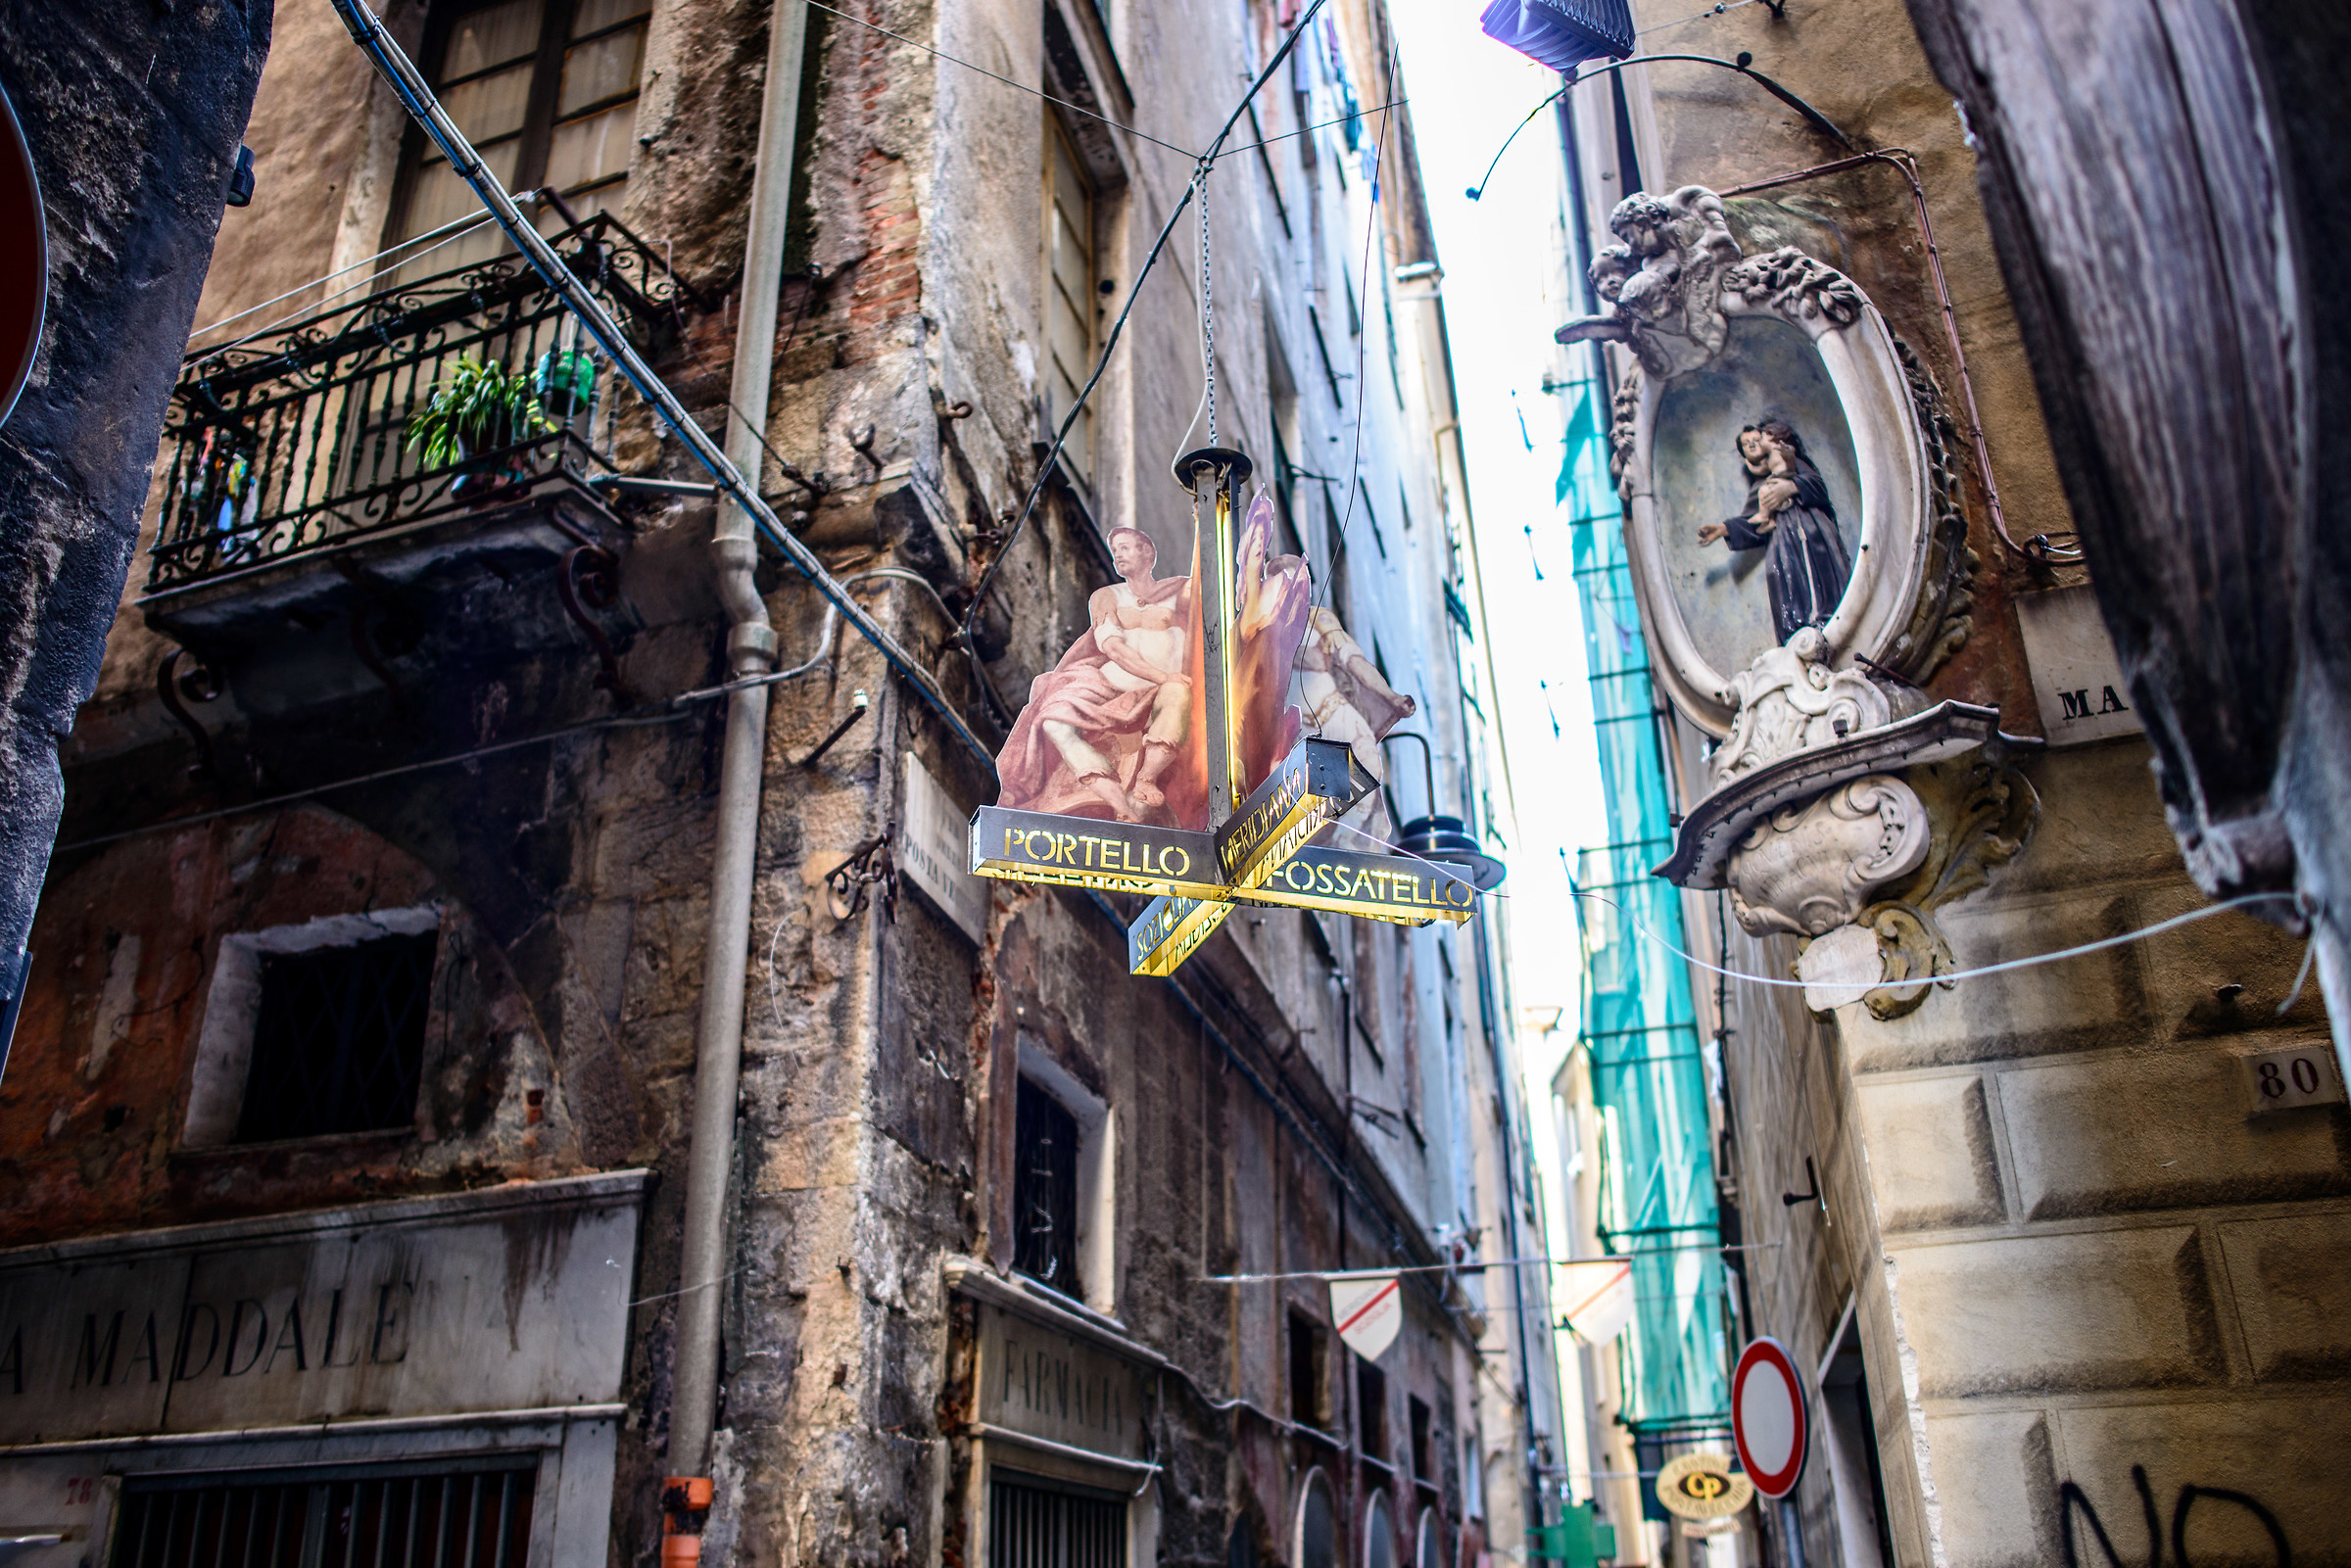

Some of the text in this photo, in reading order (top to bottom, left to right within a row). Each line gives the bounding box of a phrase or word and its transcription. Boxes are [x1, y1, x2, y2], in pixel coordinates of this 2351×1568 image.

[2057, 685, 2130, 722] MA
[1220, 768, 1301, 872] MERIDIANA
[904, 832, 938, 886] POSTA
[1004, 828, 1190, 877] PORTELLO
[1267, 861, 1473, 907] FOSSATELLO
[2258, 1058, 2321, 1098] 80
[65, 1477, 94, 1506] 78
